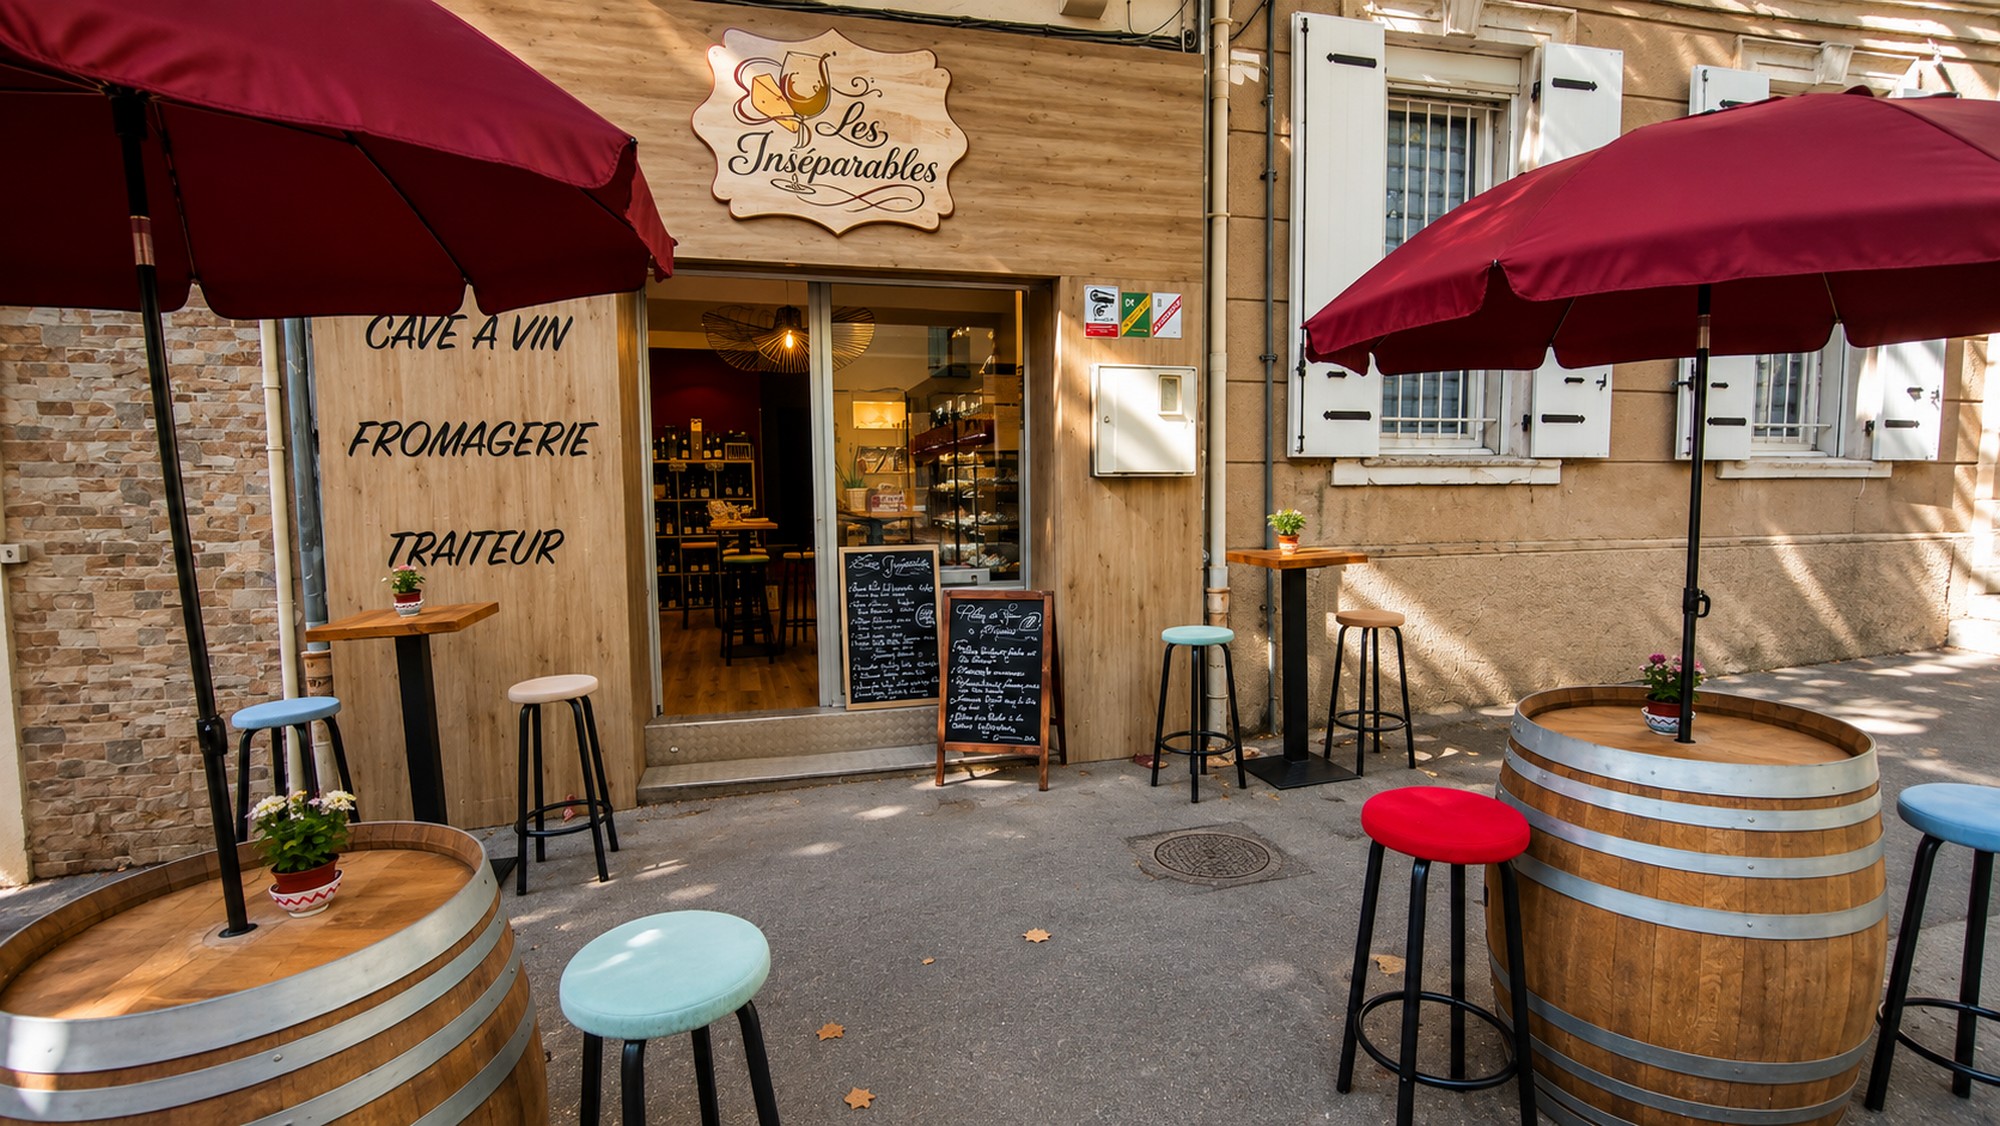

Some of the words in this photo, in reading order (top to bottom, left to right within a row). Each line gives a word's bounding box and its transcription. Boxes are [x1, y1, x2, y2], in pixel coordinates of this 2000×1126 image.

[815, 101, 888, 148] Les
[728, 130, 939, 185] Inséparables
[365, 314, 469, 350] CAVE
[512, 314, 574, 351] VIN
[347, 420, 600, 458] FROMAGERIE
[387, 528, 565, 568] TRAITEUR
